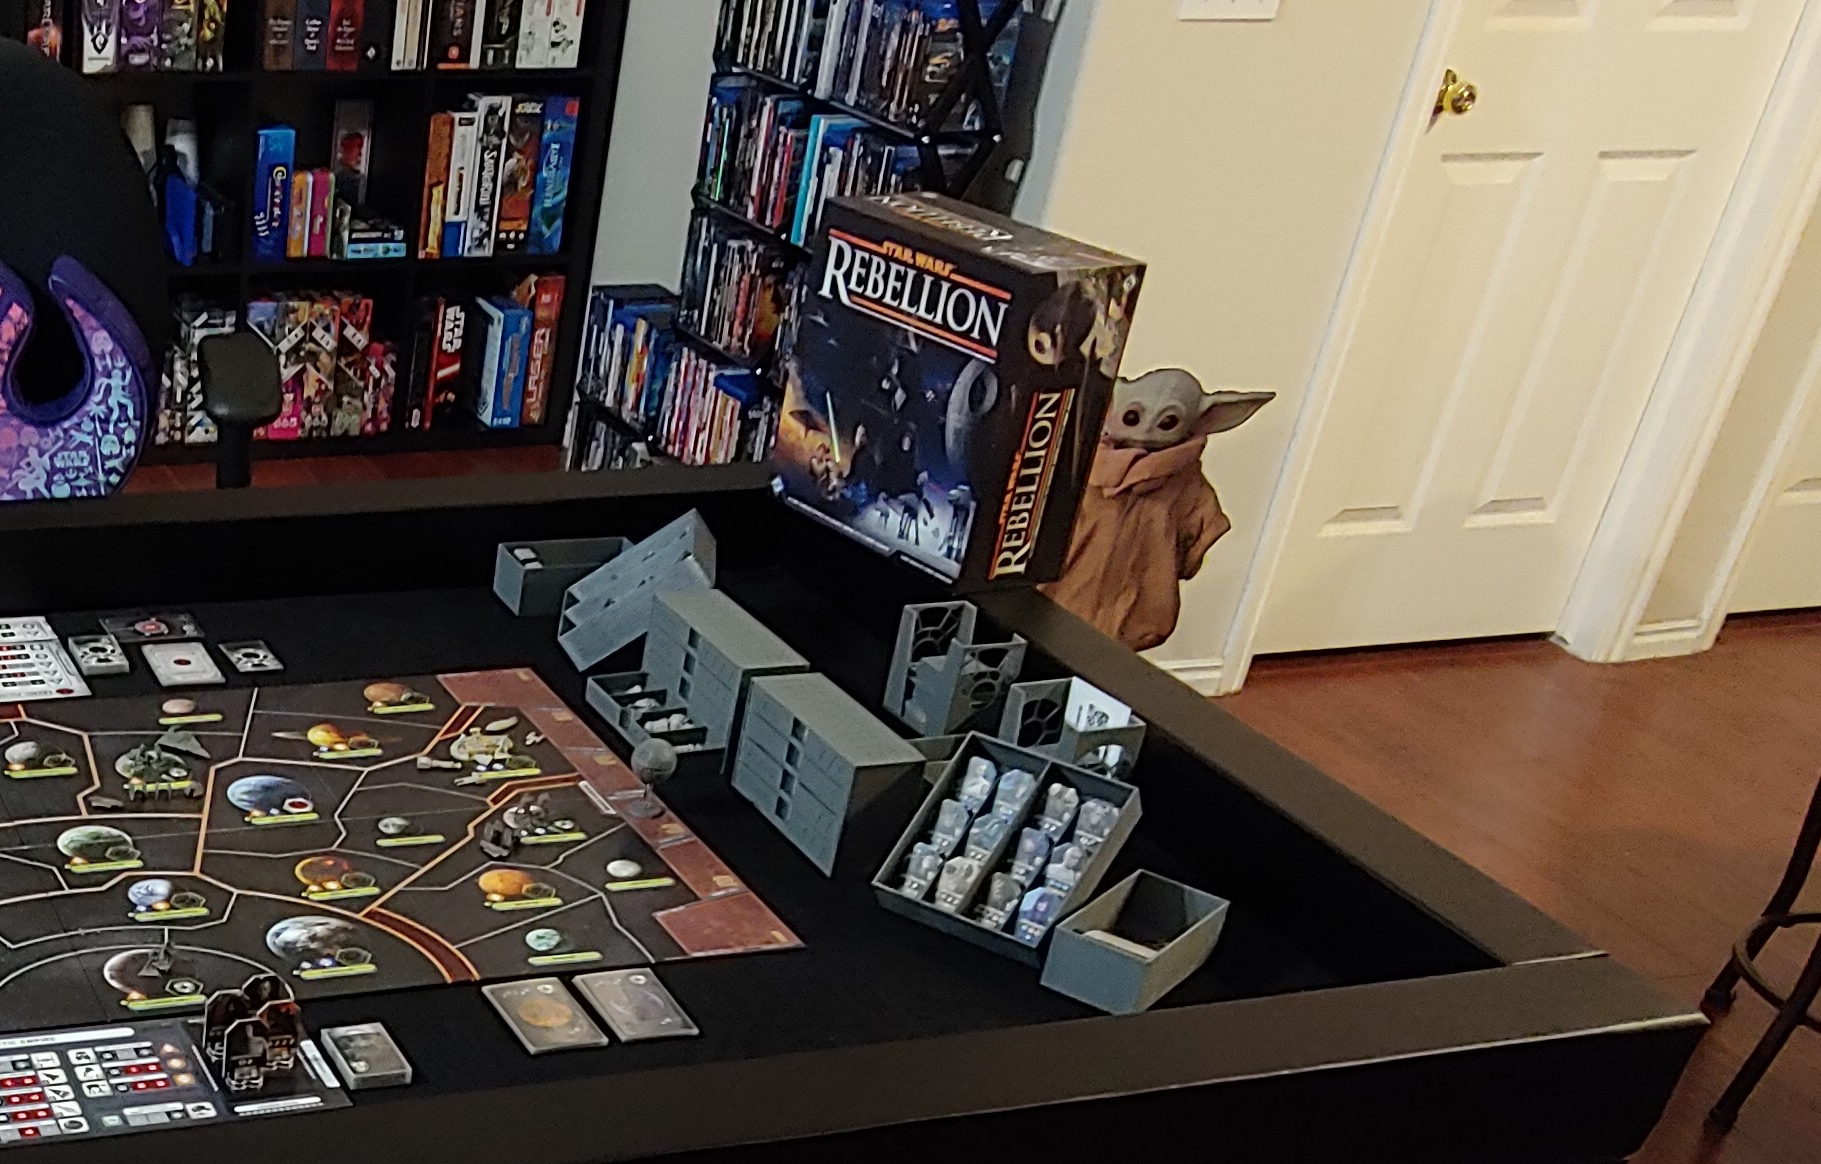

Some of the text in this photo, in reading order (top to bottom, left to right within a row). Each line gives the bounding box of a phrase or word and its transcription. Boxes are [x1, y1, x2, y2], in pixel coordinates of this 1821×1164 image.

[882, 240, 914, 264] STAR
[915, 251, 956, 278] WARS
[817, 236, 1009, 348] REBELLION
[442, 307, 455, 353] WARS
[454, 304, 466, 351] STAR
[526, 327, 546, 403] LASER
[993, 391, 1063, 577] REBELLION
